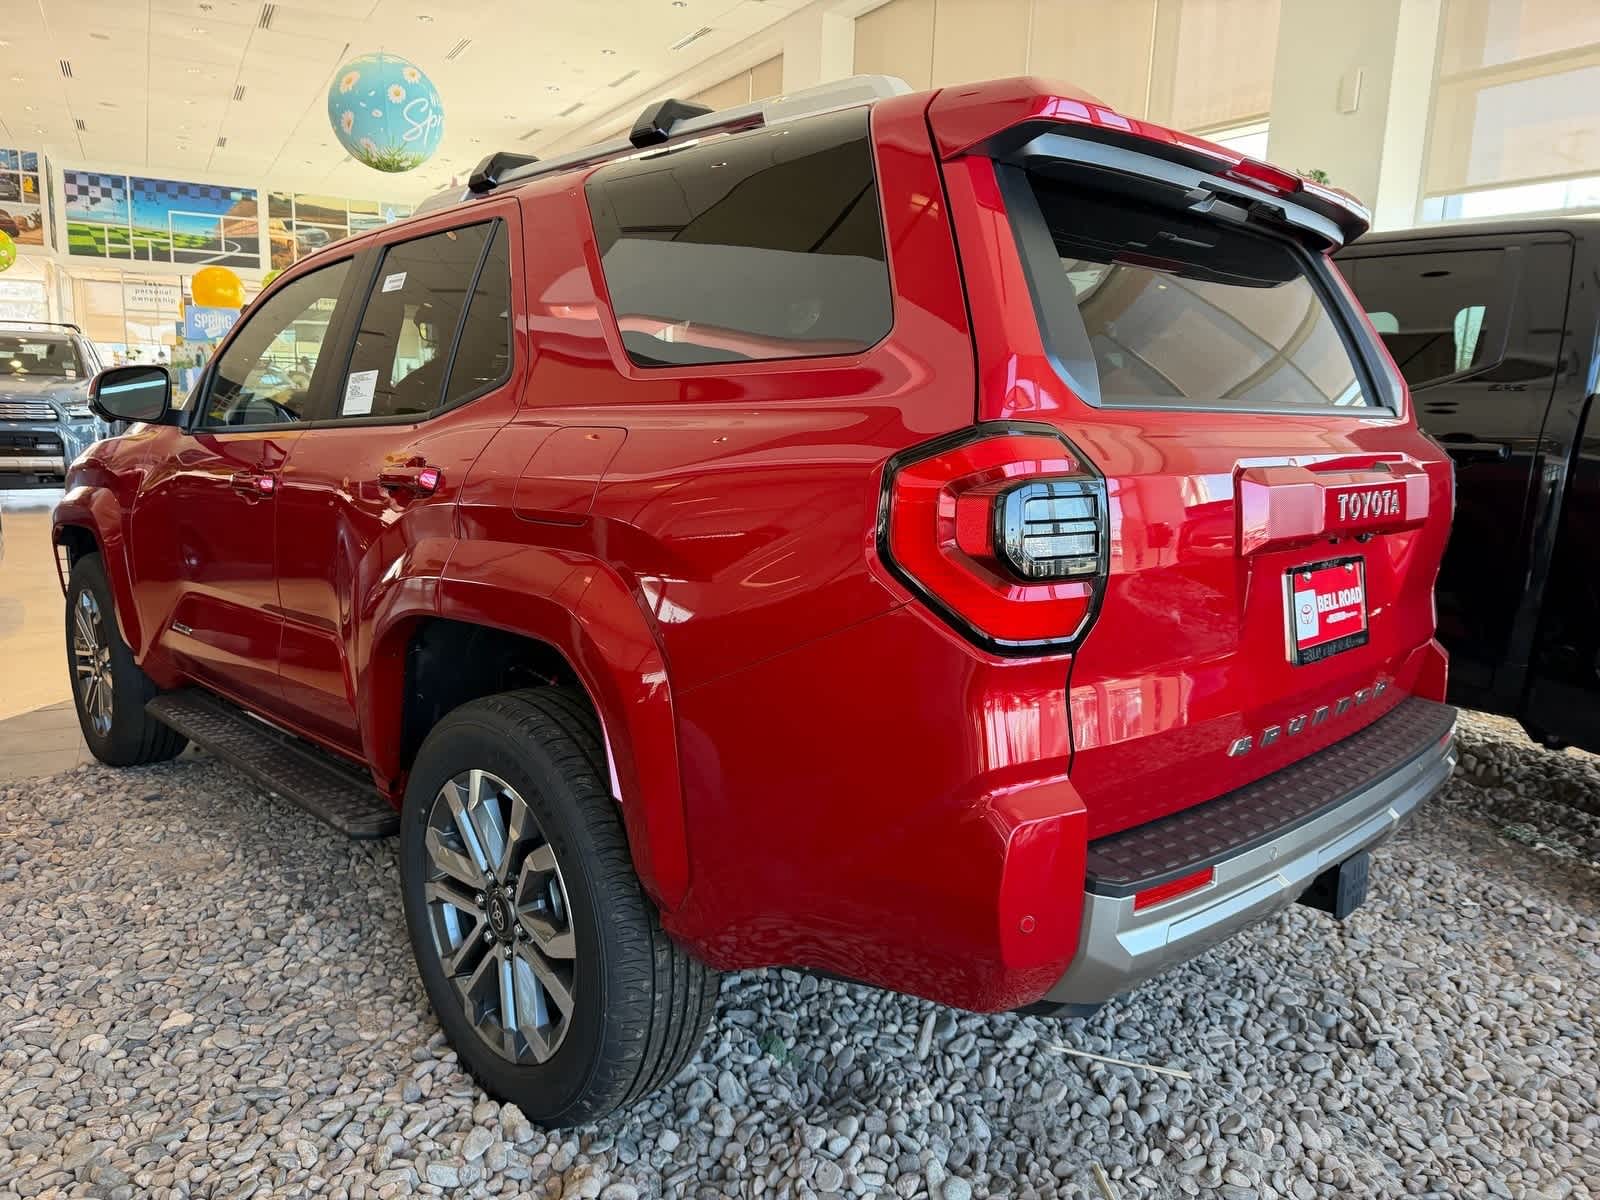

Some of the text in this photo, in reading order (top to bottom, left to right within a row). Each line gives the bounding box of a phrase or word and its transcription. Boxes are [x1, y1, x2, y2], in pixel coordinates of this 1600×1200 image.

[193, 311, 232, 330] SPRING
[1337, 489, 1400, 521] TOYOTA
[1316, 586, 1362, 613] BELL ROAD
